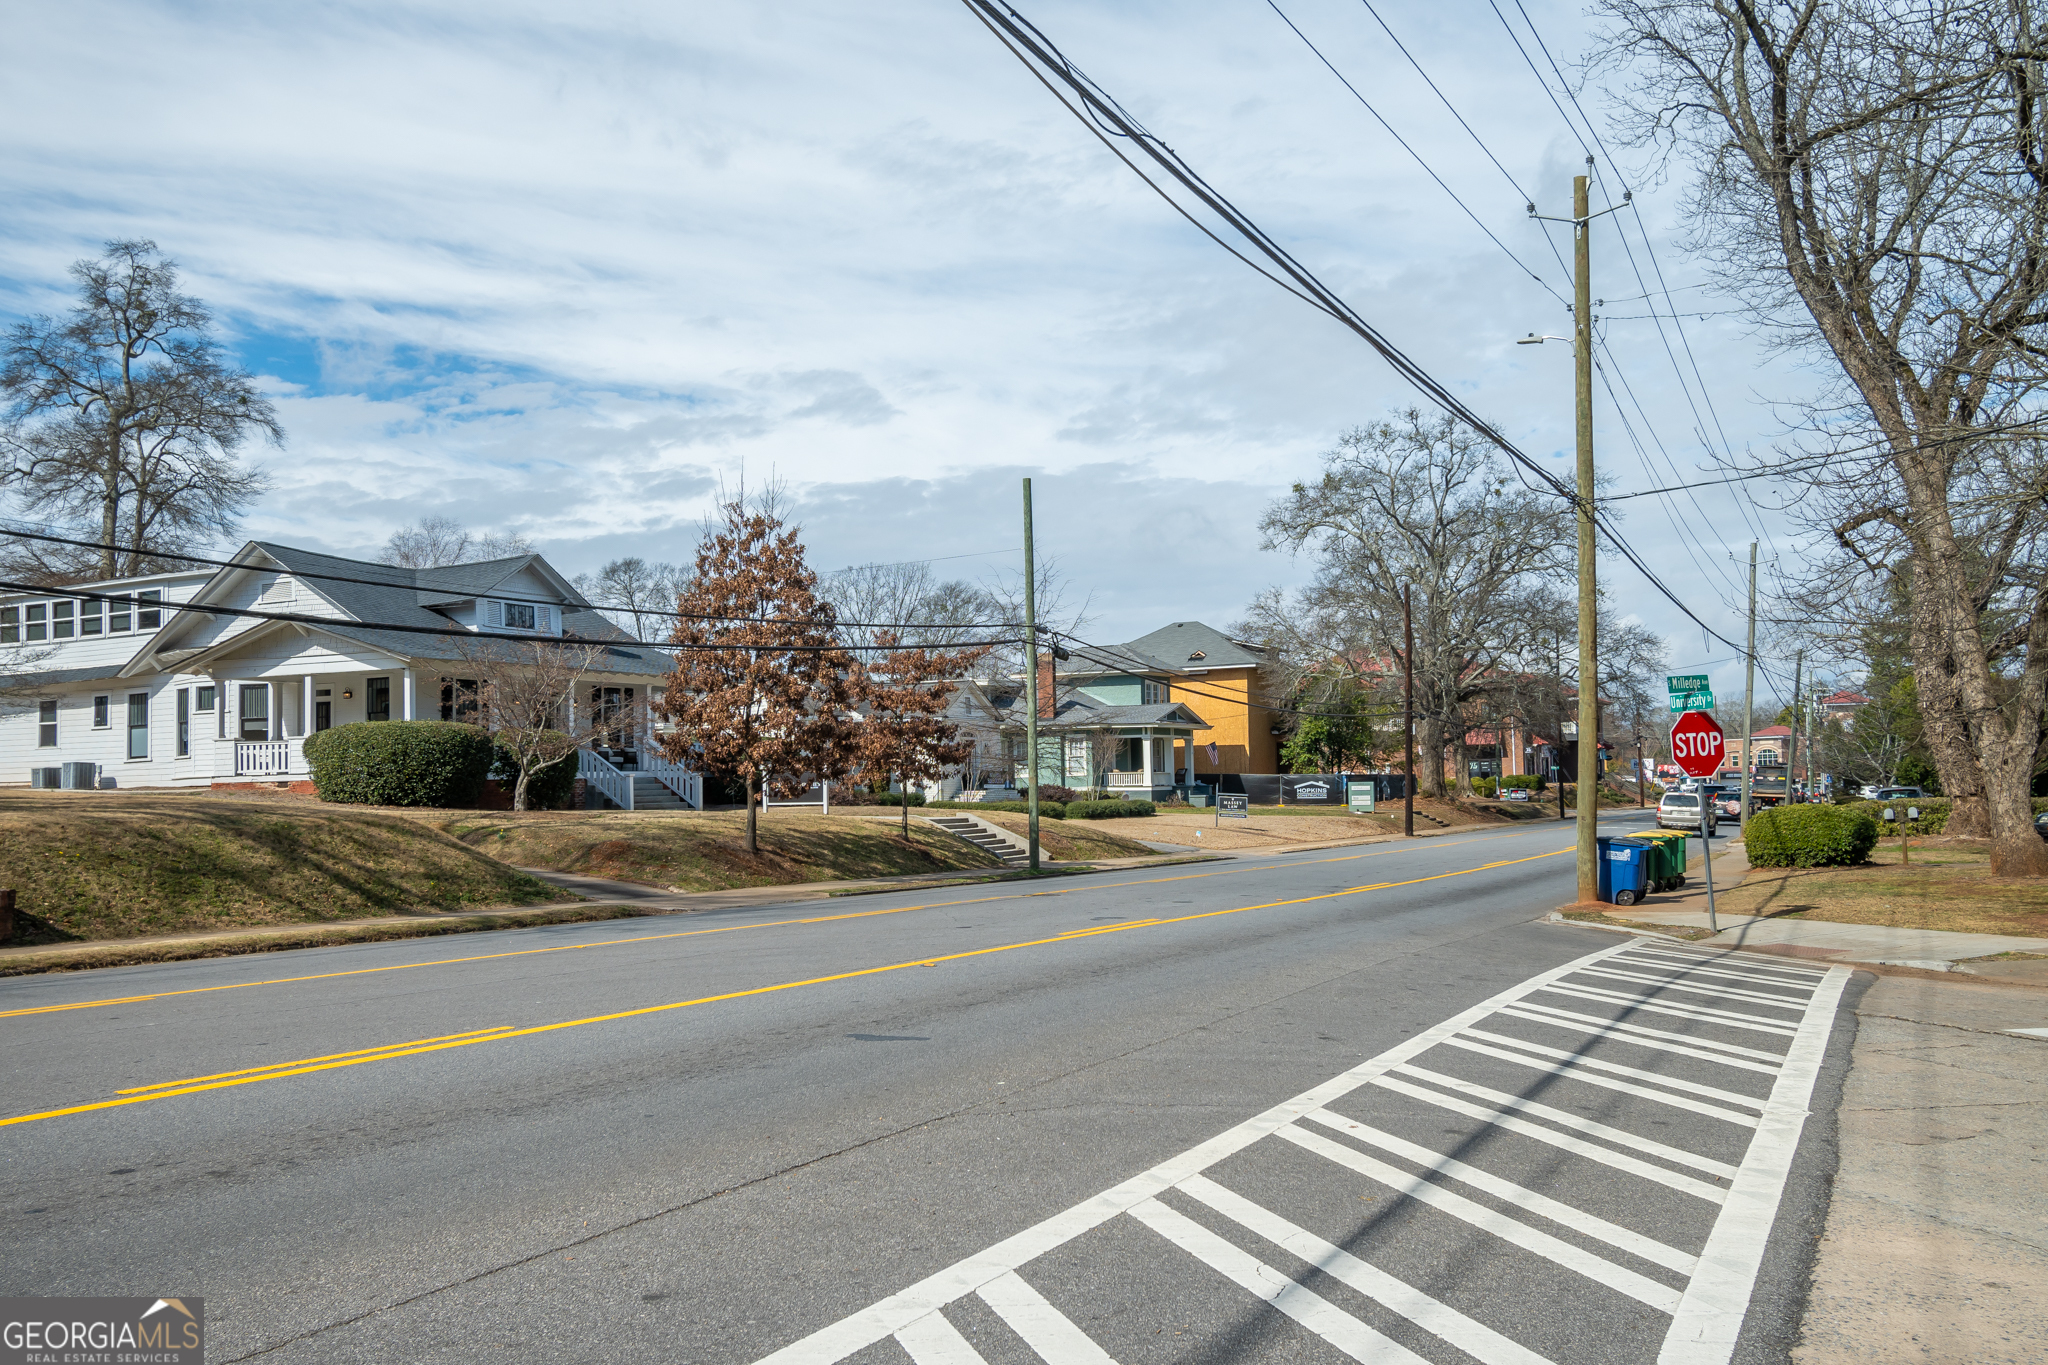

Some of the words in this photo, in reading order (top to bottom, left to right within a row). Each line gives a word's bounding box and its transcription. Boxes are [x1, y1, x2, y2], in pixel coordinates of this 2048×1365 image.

[1672, 676, 1701, 691] Milledge
[1670, 694, 1706, 708] University
[1675, 731, 1722, 758] STOP
